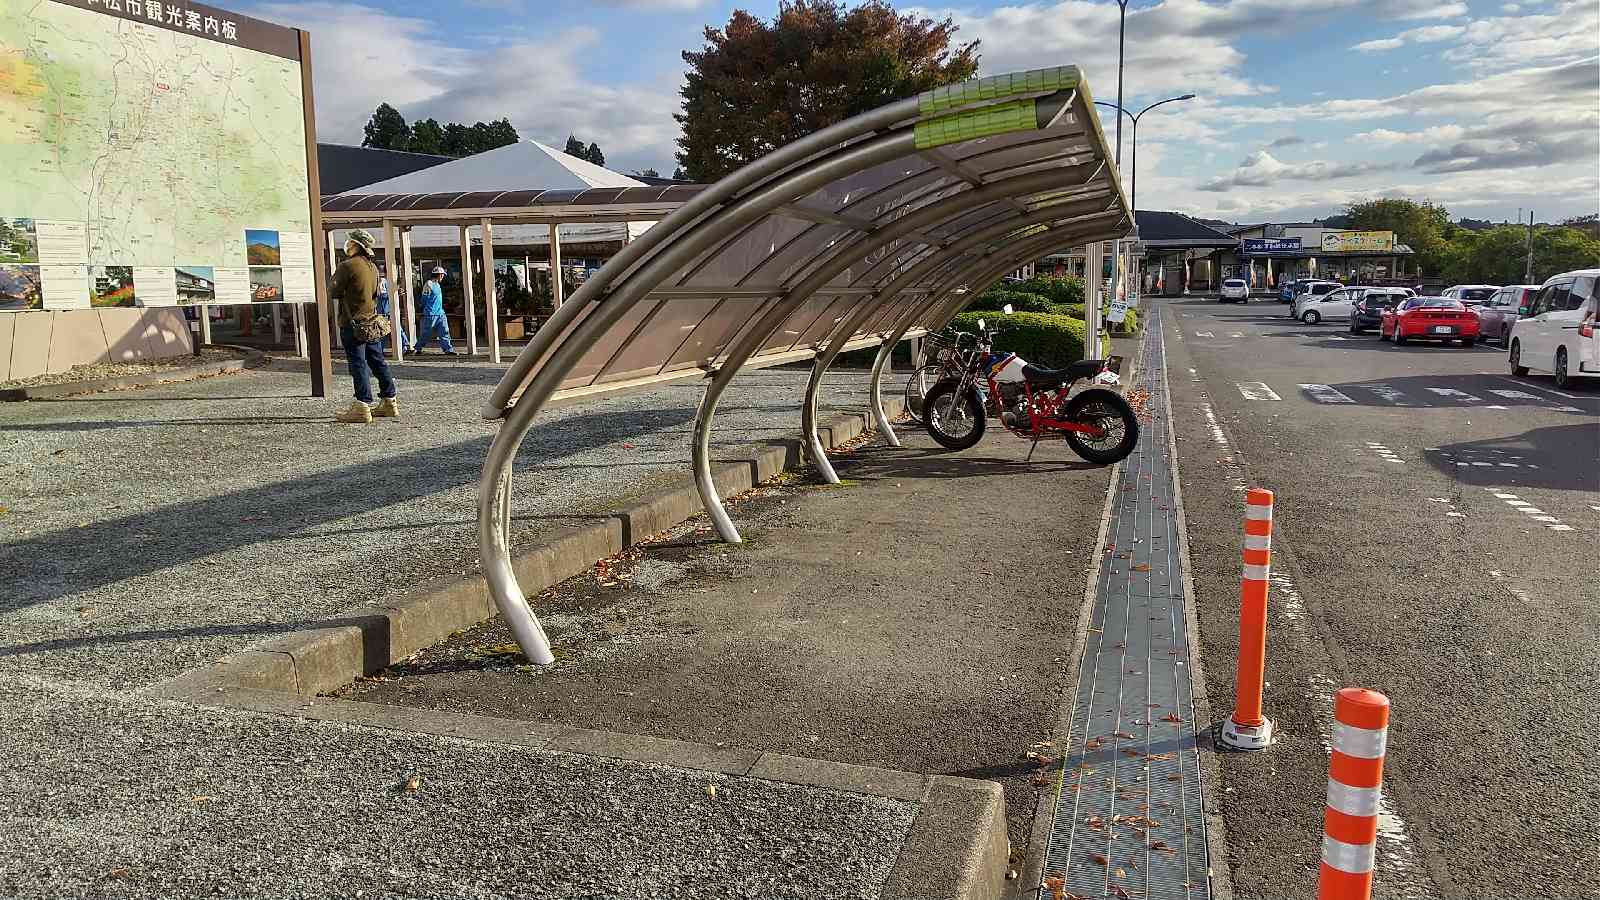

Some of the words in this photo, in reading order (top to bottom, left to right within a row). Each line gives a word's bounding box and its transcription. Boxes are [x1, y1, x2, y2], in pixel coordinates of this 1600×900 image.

[87, 0, 238, 41] 松市観光案内板
